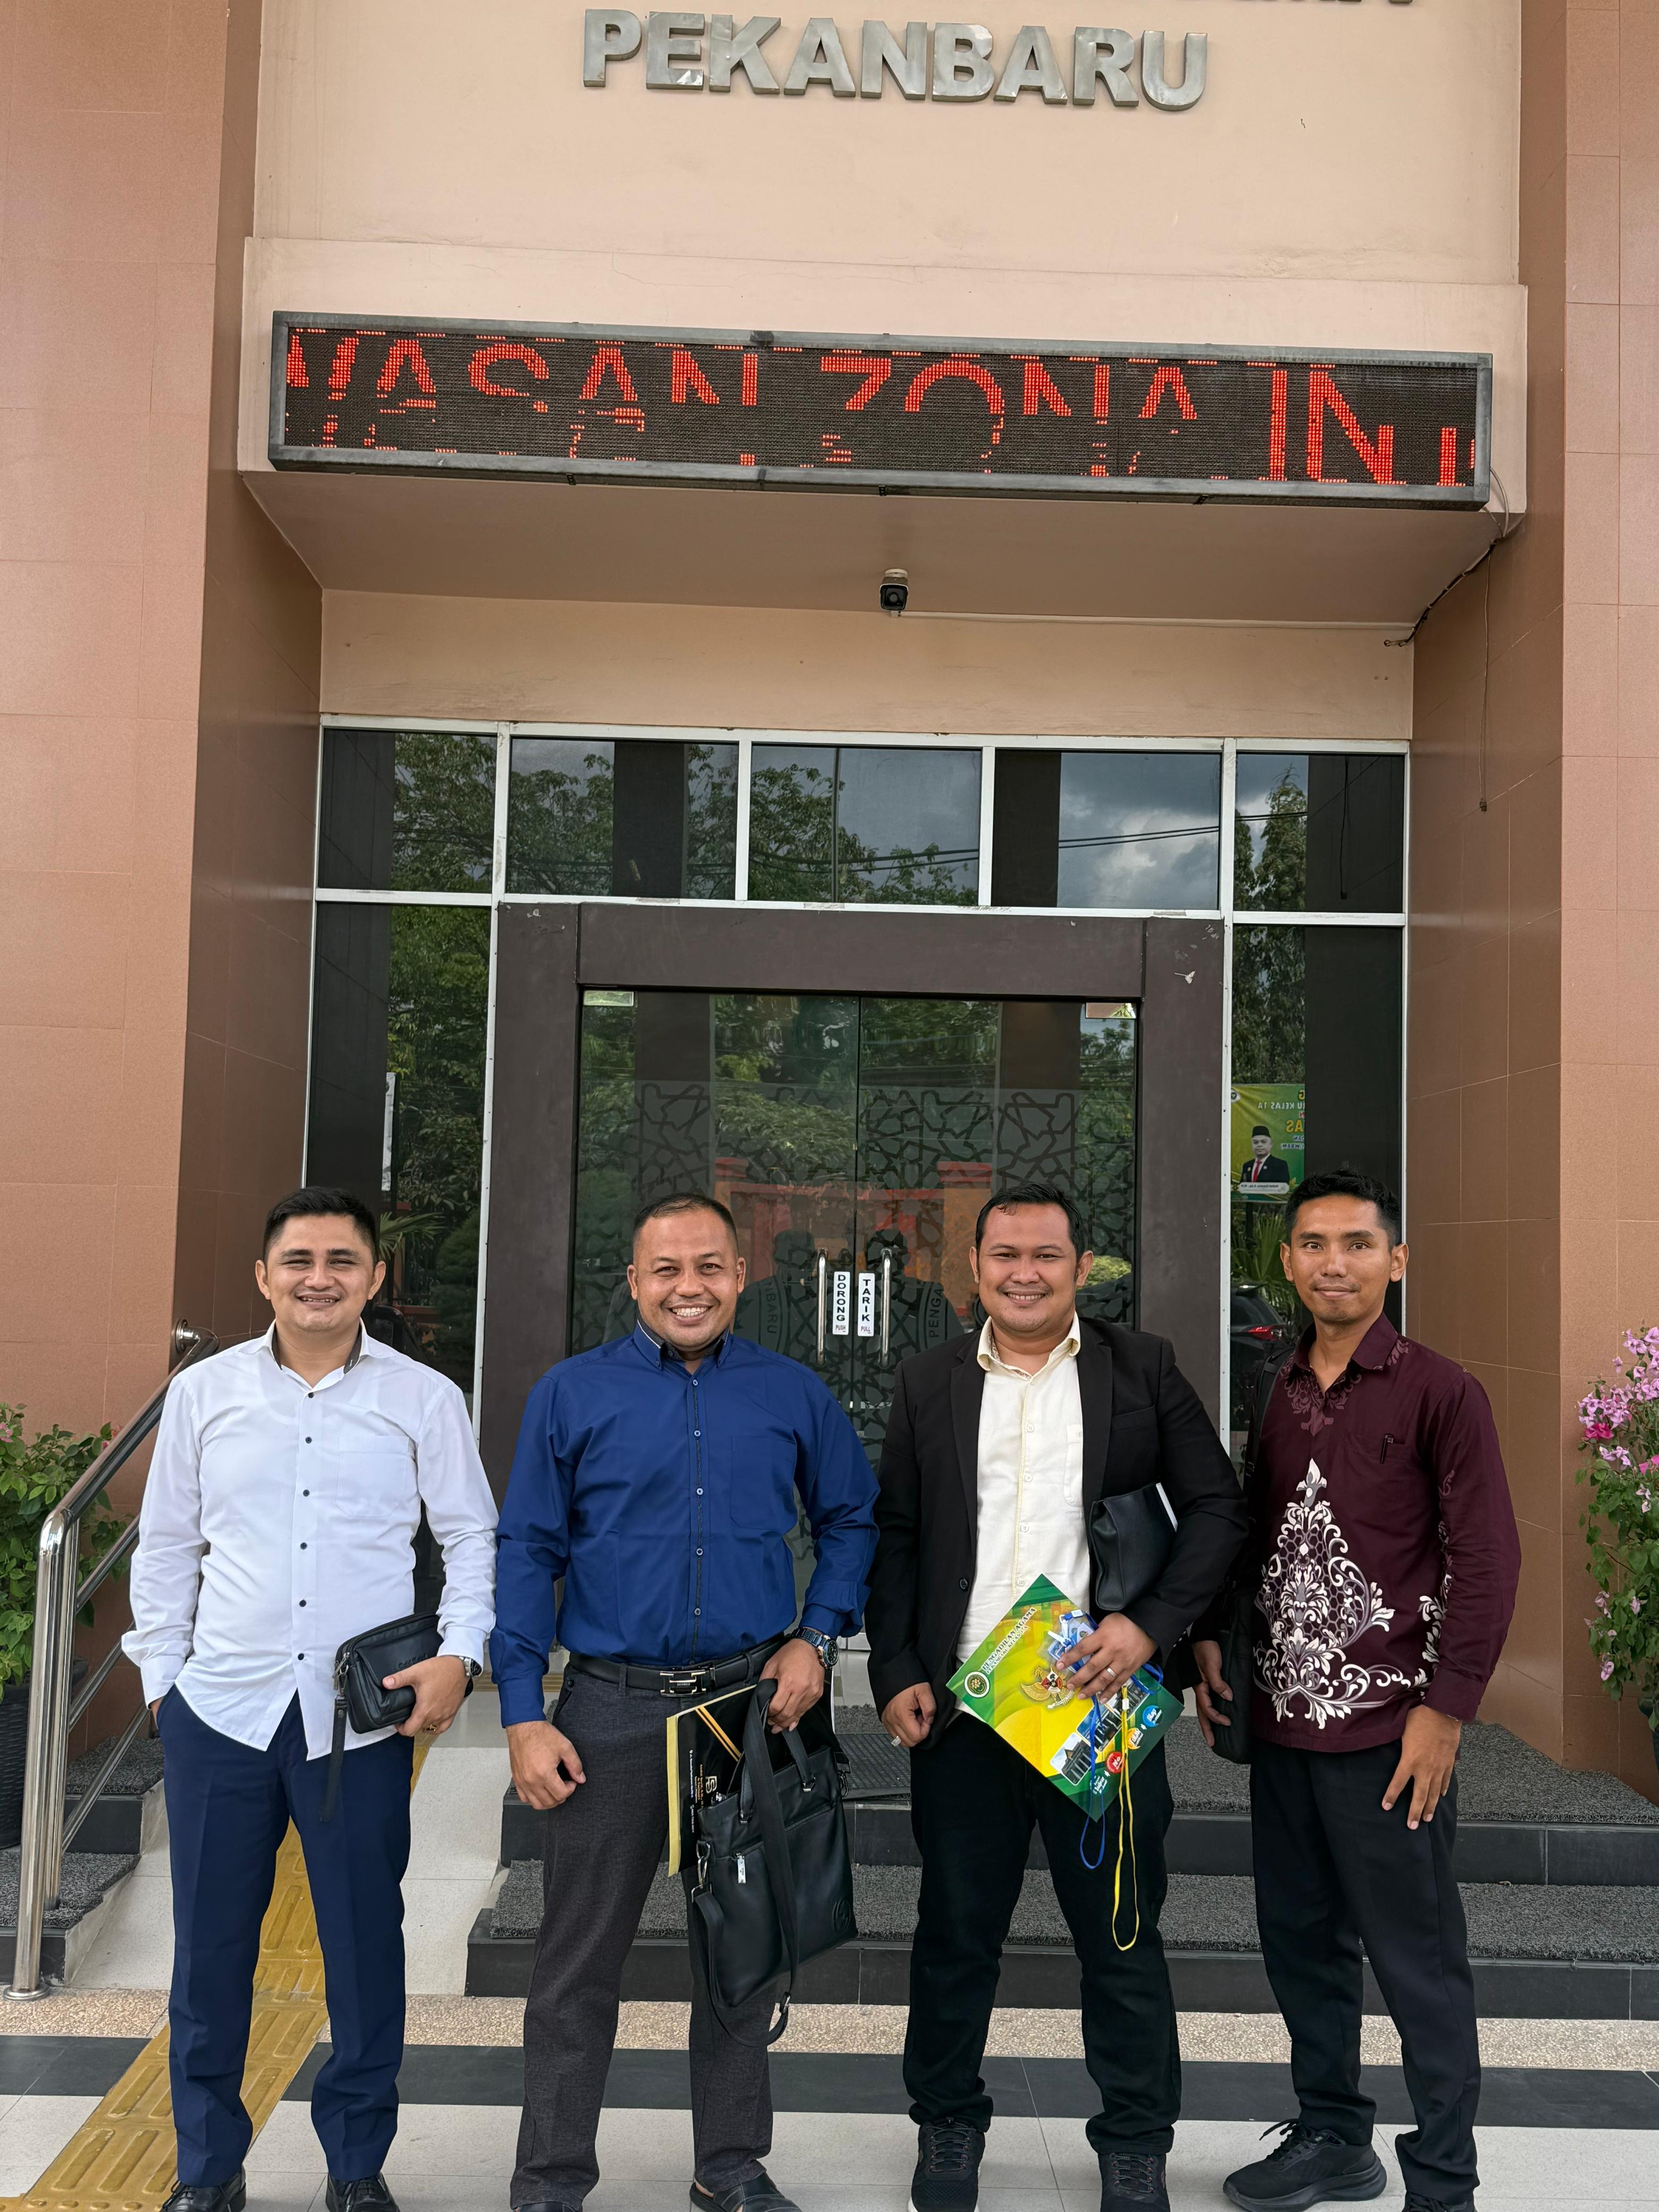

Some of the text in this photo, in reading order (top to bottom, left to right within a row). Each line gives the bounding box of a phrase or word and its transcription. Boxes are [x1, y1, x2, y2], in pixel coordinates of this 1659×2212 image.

[583, 9, 1209, 112] PEKANBARU
[836, 1275, 847, 1321] DORONG
[861, 1279, 871, 1321] TARIK
[981, 1607, 1036, 1671] PENGADILAN AGAMA
